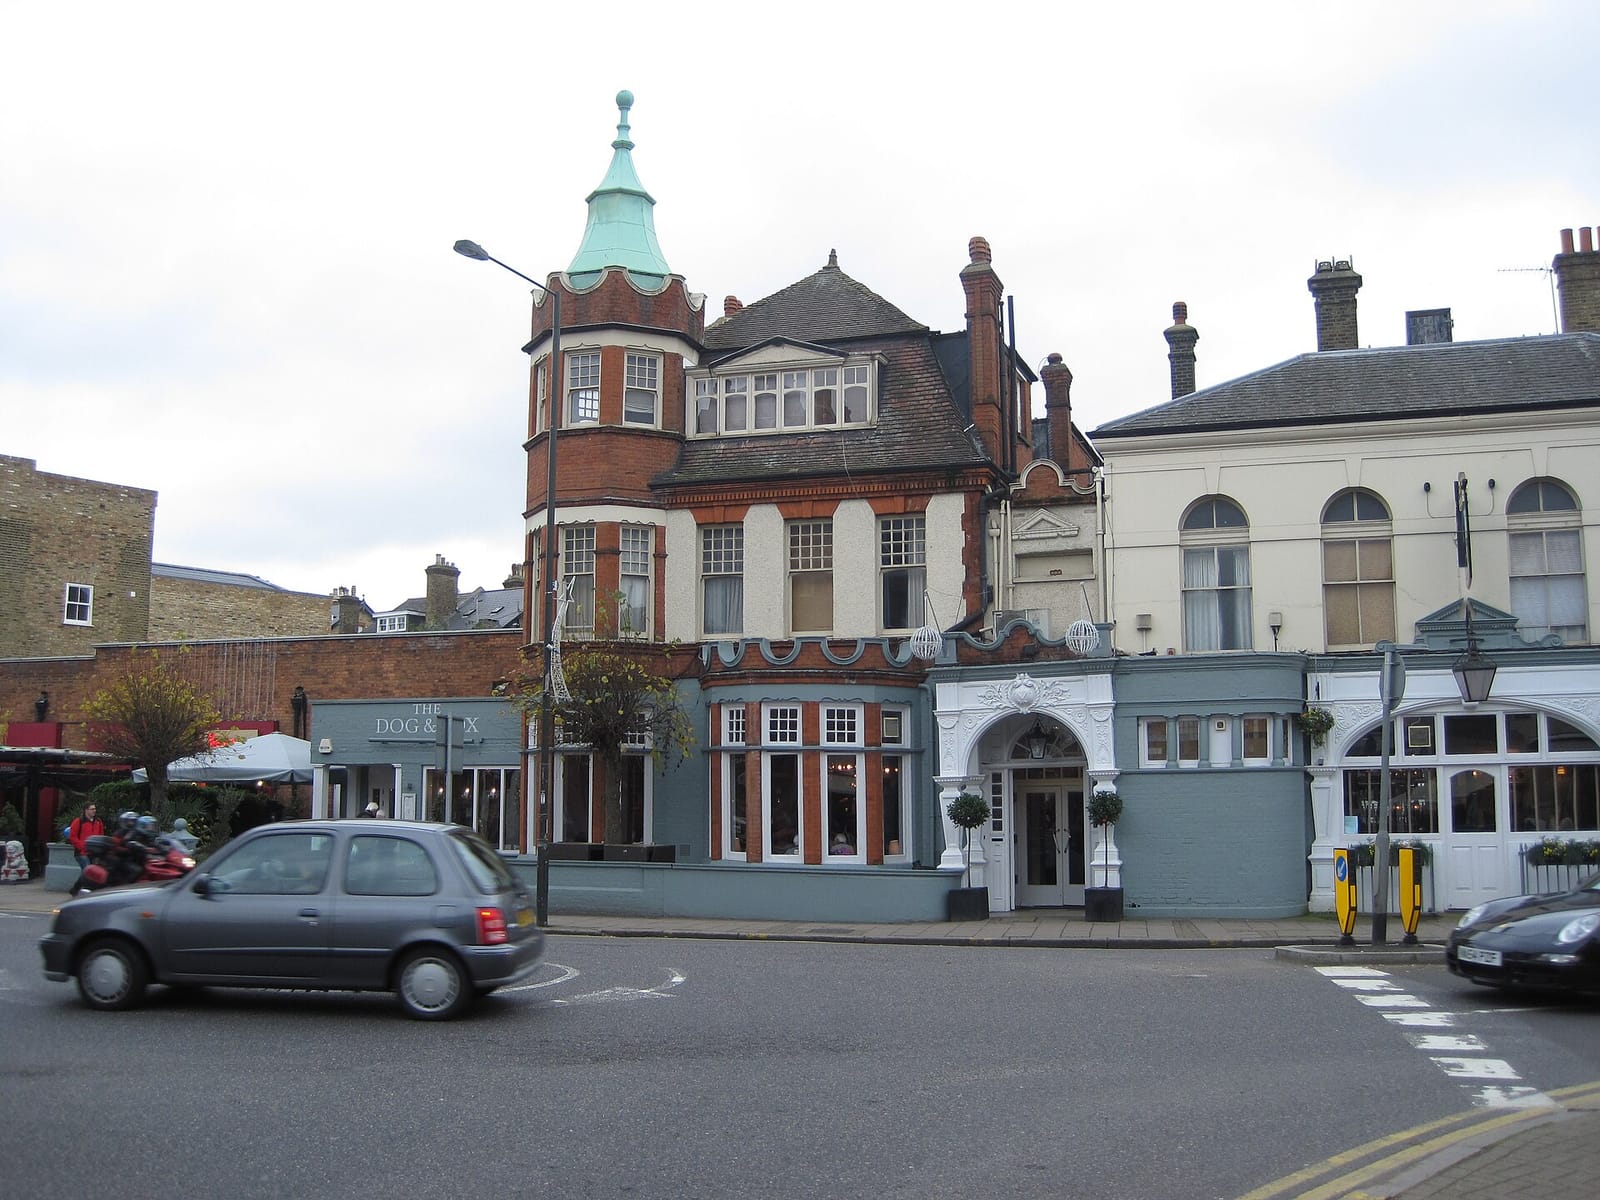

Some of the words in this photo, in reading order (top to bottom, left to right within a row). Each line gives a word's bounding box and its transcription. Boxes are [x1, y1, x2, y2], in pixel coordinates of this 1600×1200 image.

[413, 703, 441, 714] THE
[376, 718, 419, 733] DOG
[423, 718, 437, 733] &
